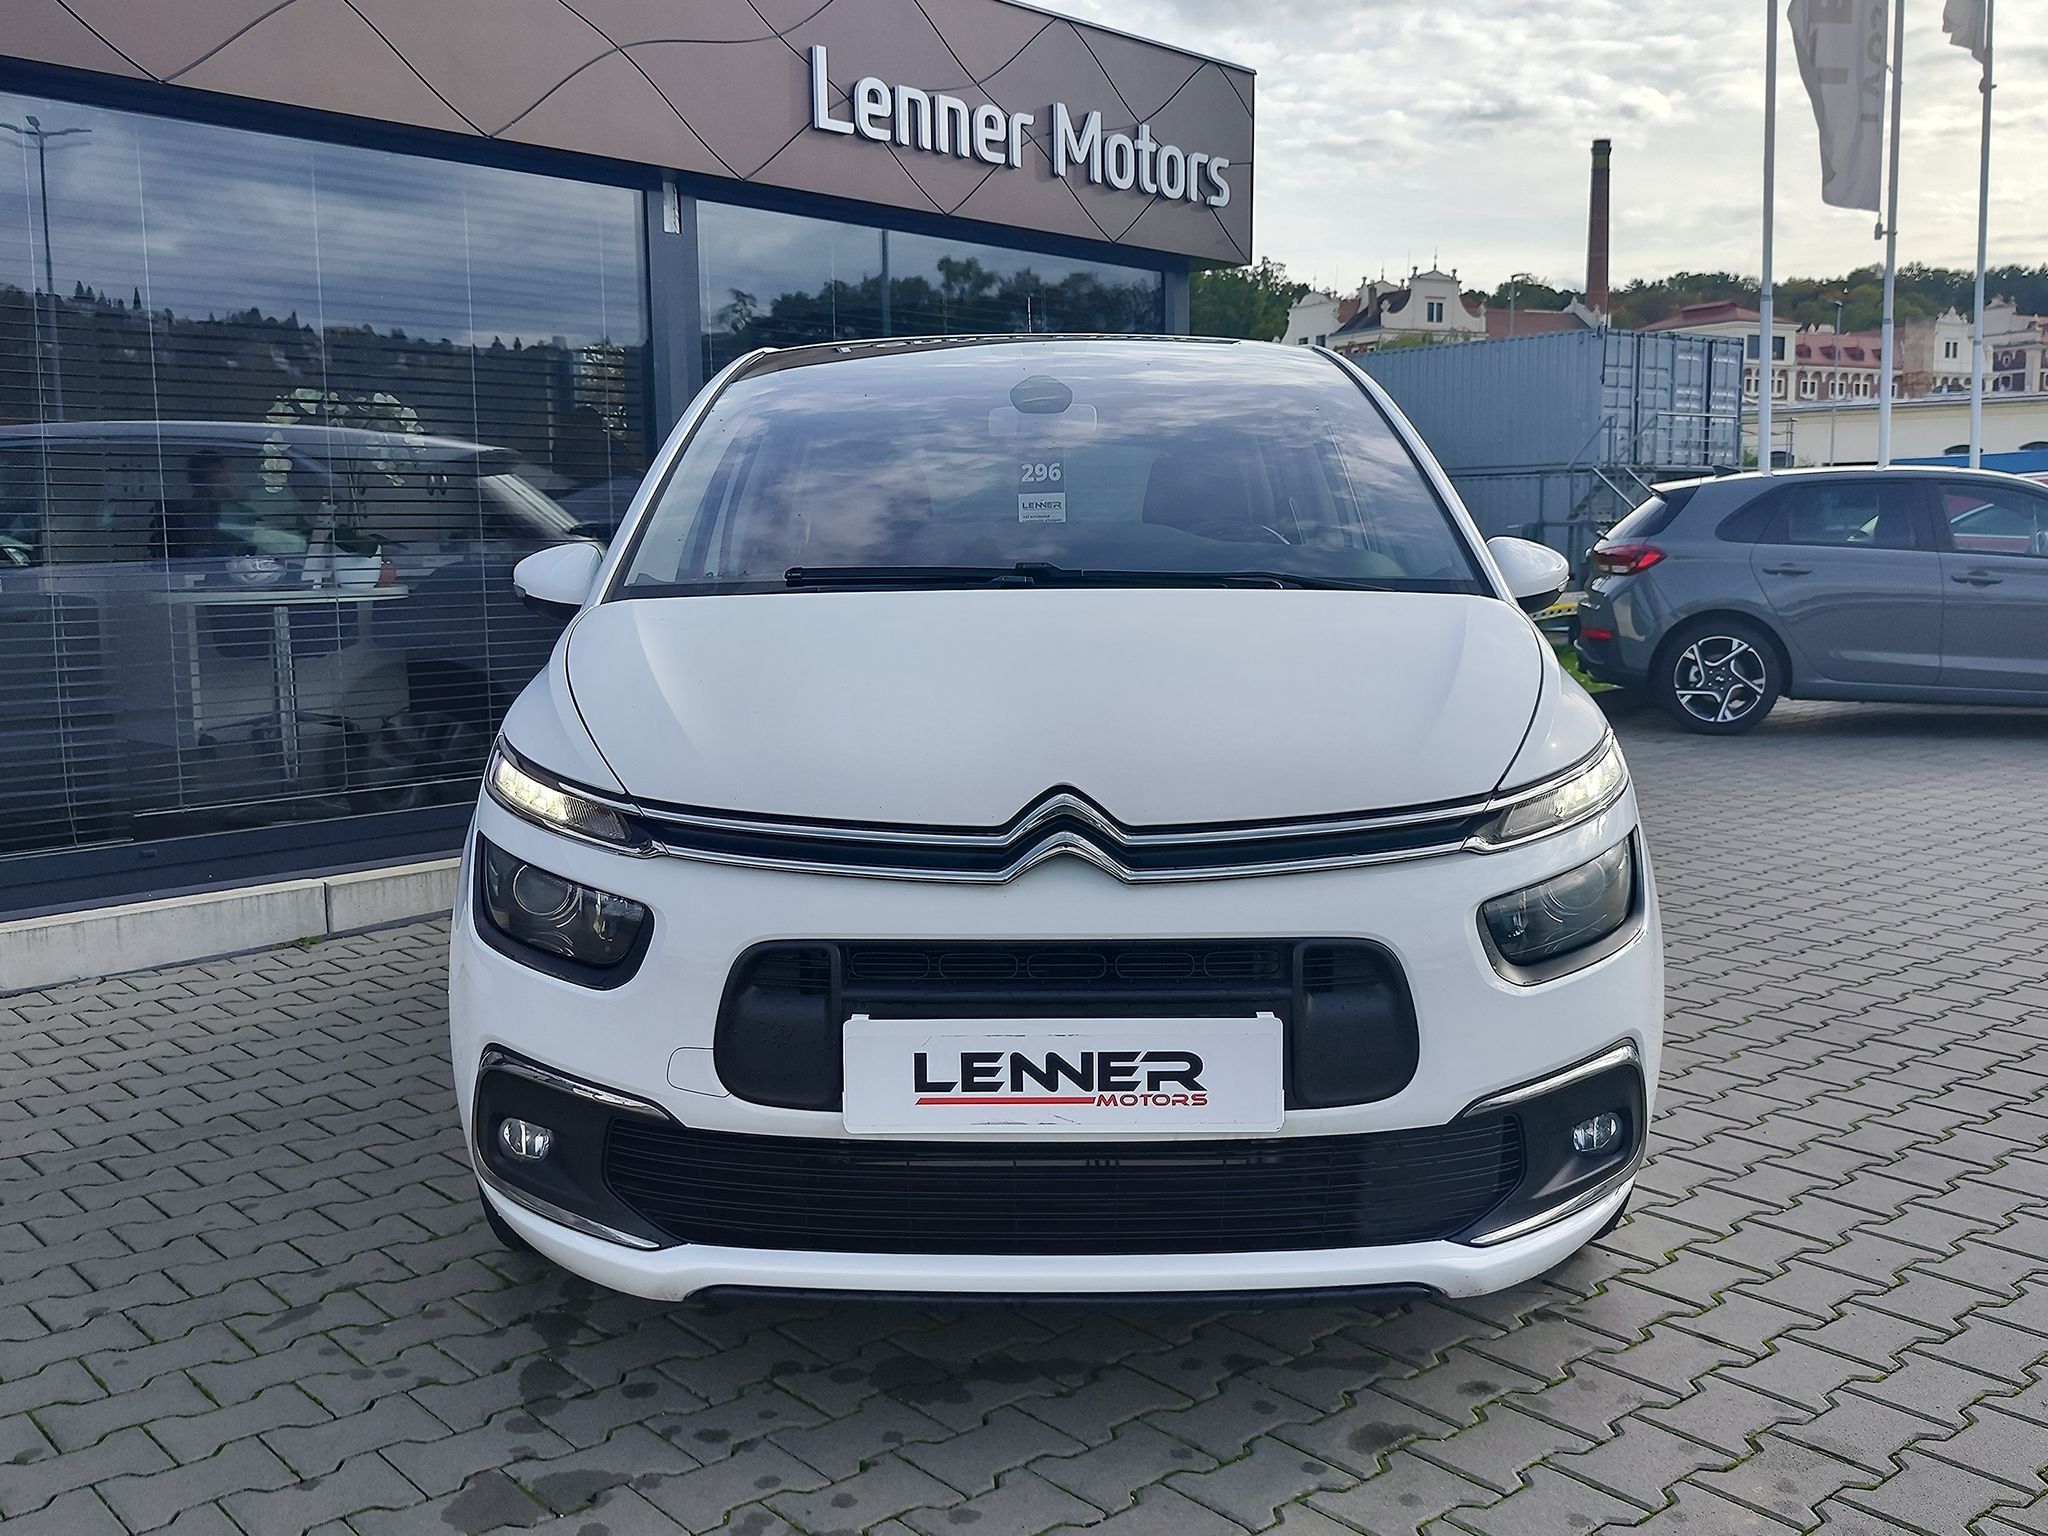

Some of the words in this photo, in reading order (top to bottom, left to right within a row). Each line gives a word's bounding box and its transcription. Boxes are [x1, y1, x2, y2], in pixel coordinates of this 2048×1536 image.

[811, 44, 1035, 169] Lenner
[1052, 102, 1231, 208] Motors
[1021, 462, 1062, 482] 296
[1022, 501, 1062, 509] LENNER
[913, 1050, 1208, 1093] LENNER
[1096, 1093, 1208, 1107] MOTORS
